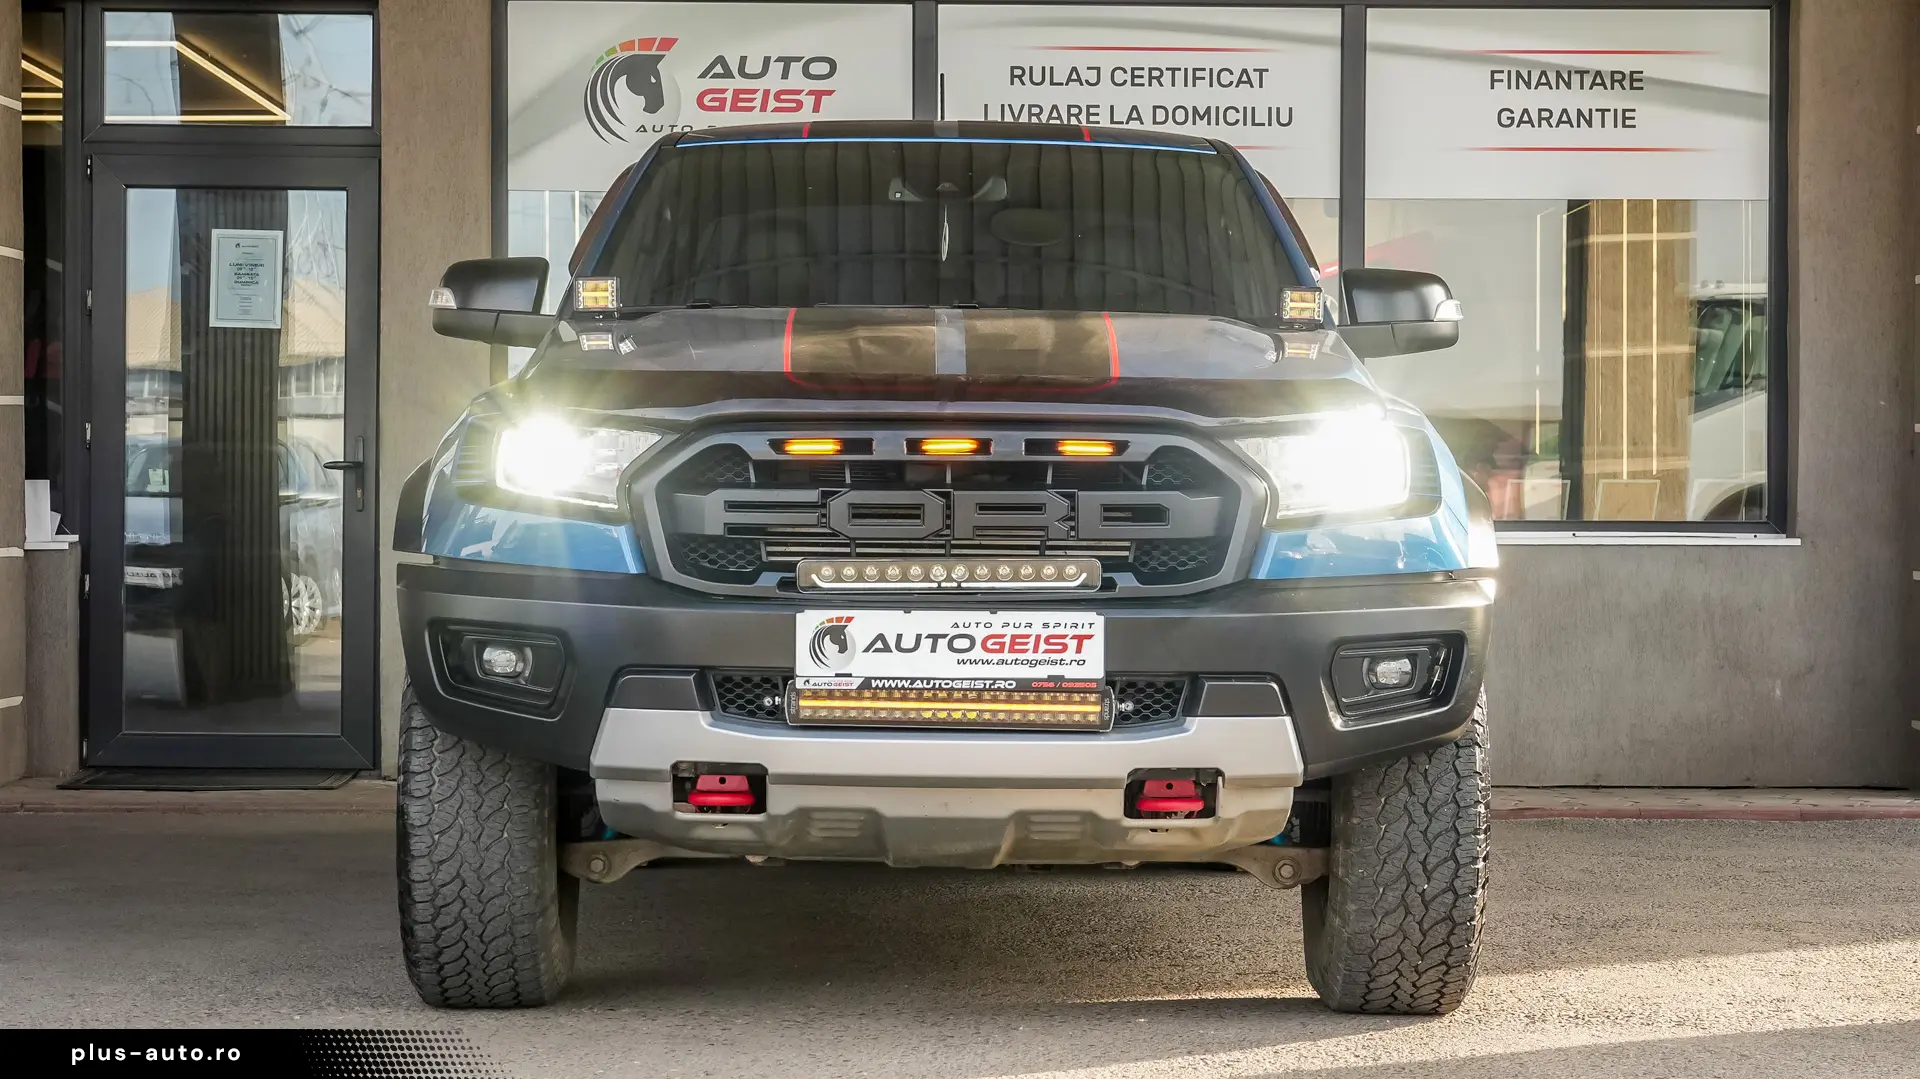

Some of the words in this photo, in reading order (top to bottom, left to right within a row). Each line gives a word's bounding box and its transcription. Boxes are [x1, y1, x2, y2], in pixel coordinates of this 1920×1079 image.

[697, 55, 838, 81] AUTO
[1009, 65, 1101, 87] RULAJ
[1110, 66, 1269, 89] CERTIFICAT
[1490, 69, 1645, 91] FINANTARE
[696, 88, 837, 113] GEIST
[1109, 104, 1144, 125] LA
[1152, 105, 1294, 127] DOMICILIU
[1496, 107, 1637, 129] GARANTIE
[635, 124, 694, 133] AUTO
[690, 488, 1206, 541] FORD
[1042, 622, 1096, 630] SPIRIT
[862, 633, 1096, 655] AUTOGEIST
[956, 657, 1086, 668] www.autogeist.ro
[871, 679, 1017, 689] WWW.AUTOGEIST.RO
